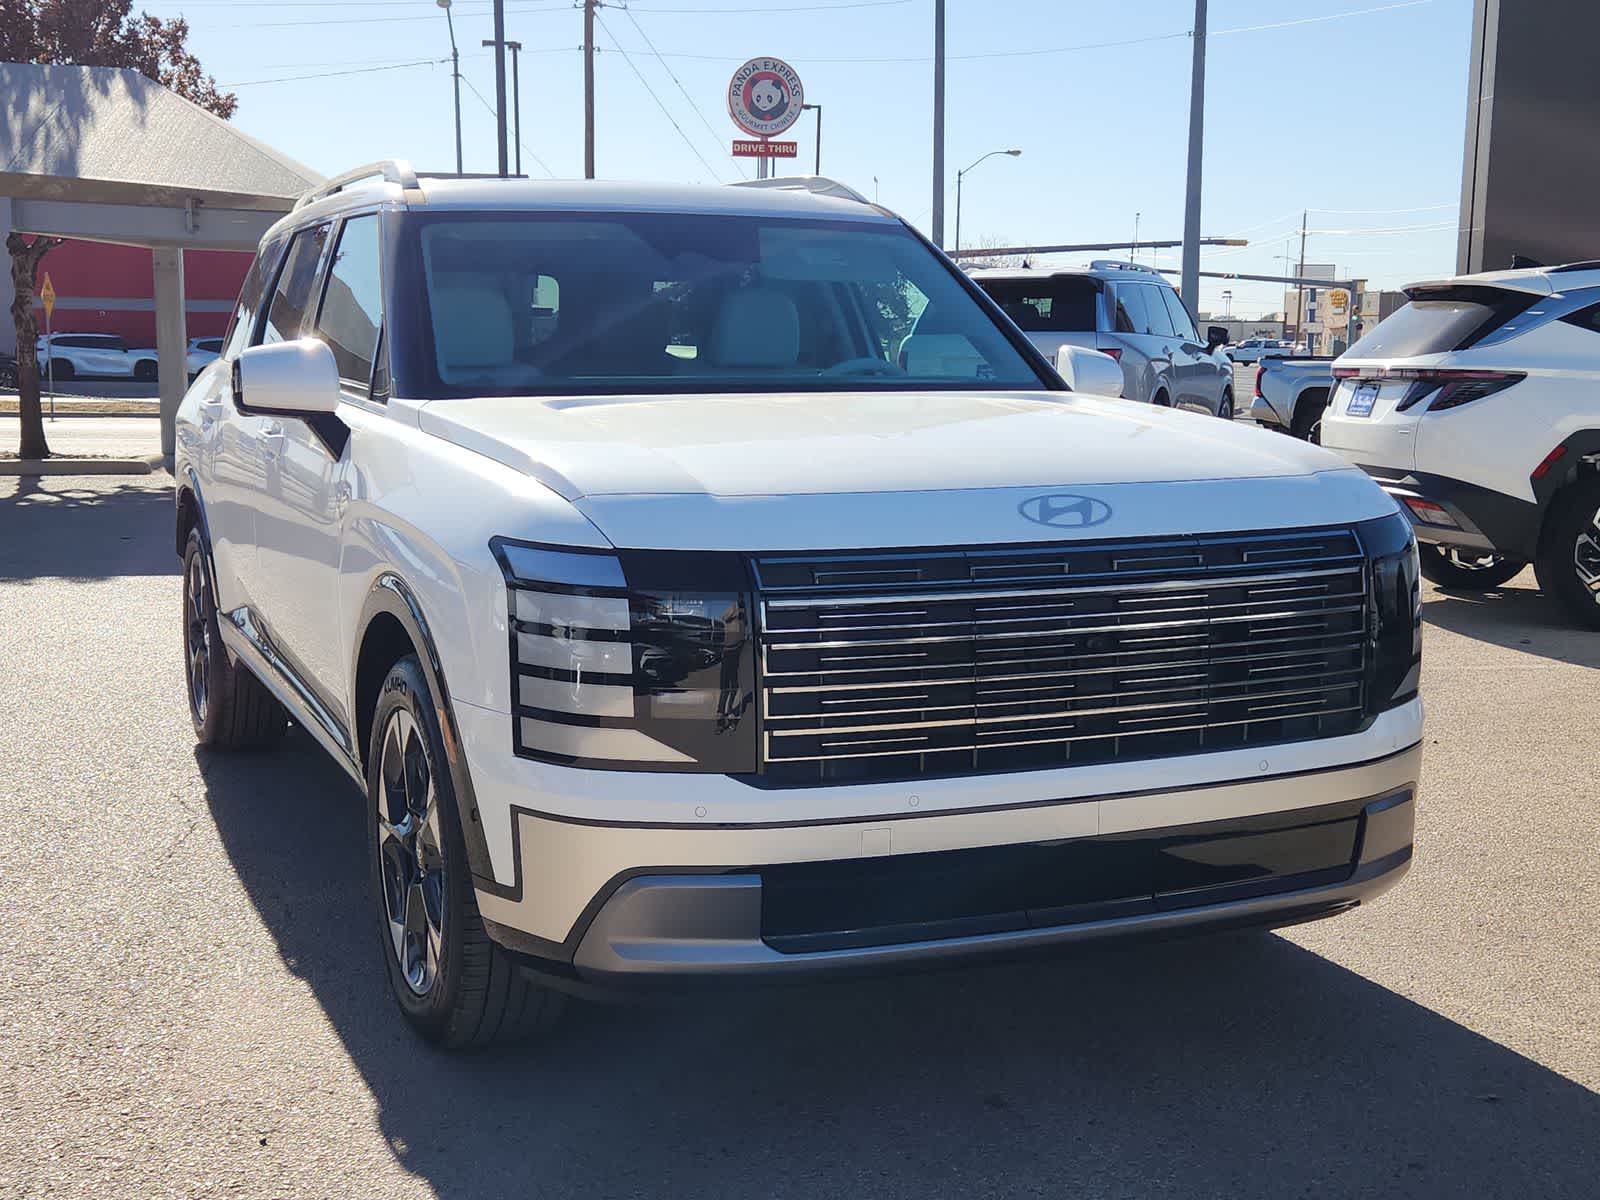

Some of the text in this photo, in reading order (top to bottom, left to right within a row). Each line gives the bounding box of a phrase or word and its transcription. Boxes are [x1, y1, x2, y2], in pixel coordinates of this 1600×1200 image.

[732, 61, 801, 97] PANDA EXPRESS
[734, 143, 796, 154] DRIVE THRU
